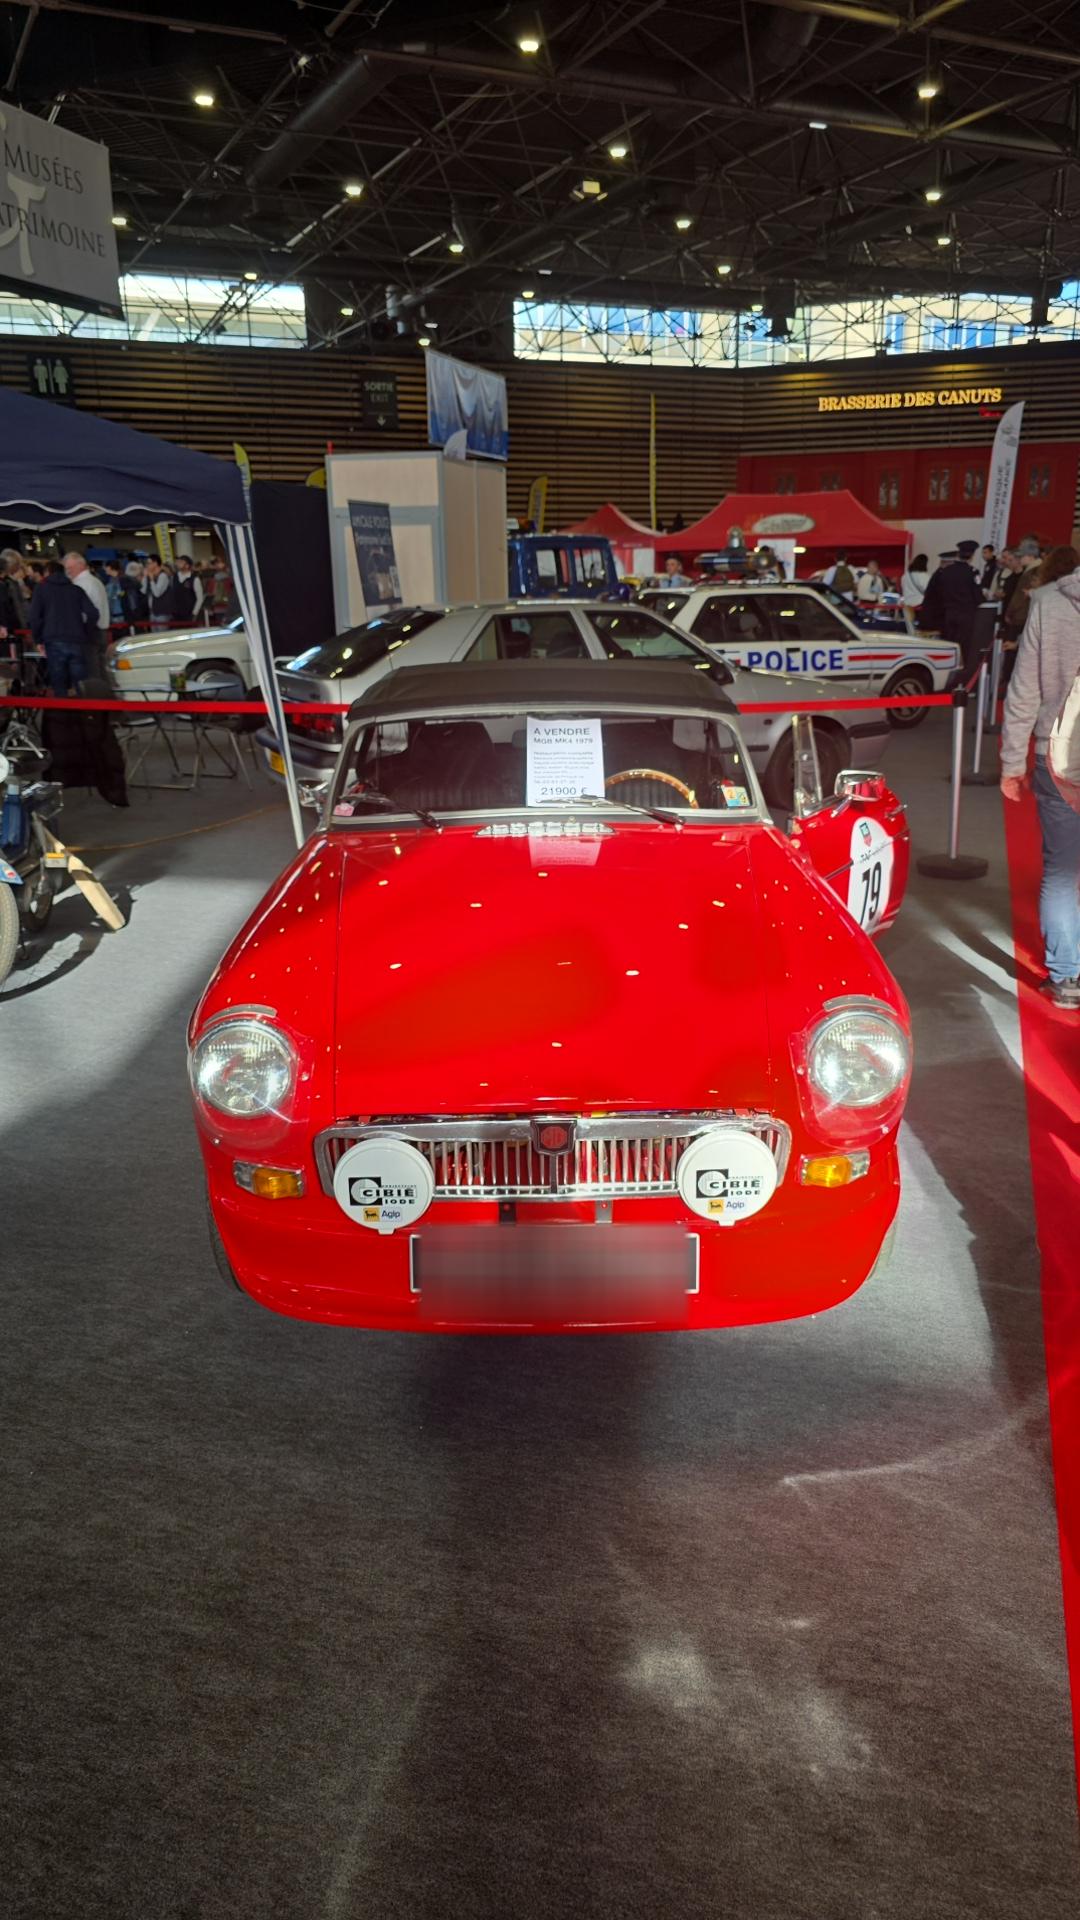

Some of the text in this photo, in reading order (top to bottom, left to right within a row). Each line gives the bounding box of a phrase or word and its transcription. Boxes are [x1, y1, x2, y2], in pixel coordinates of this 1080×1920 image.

[4, 141, 84, 194] MUSÉES
[0, 202, 106, 257] TRIMOINE
[818, 388, 1003, 412] BRASSERIE DES CANUTS
[747, 649, 844, 673] POLICE
[533, 727, 591, 736] A VENDRE
[540, 786, 577, 796] 21900
[860, 861, 882, 926] 79
[384, 1198, 416, 1206] IODE
[727, 1201, 744, 1209] Agip
[381, 1210, 400, 1219] Agip
